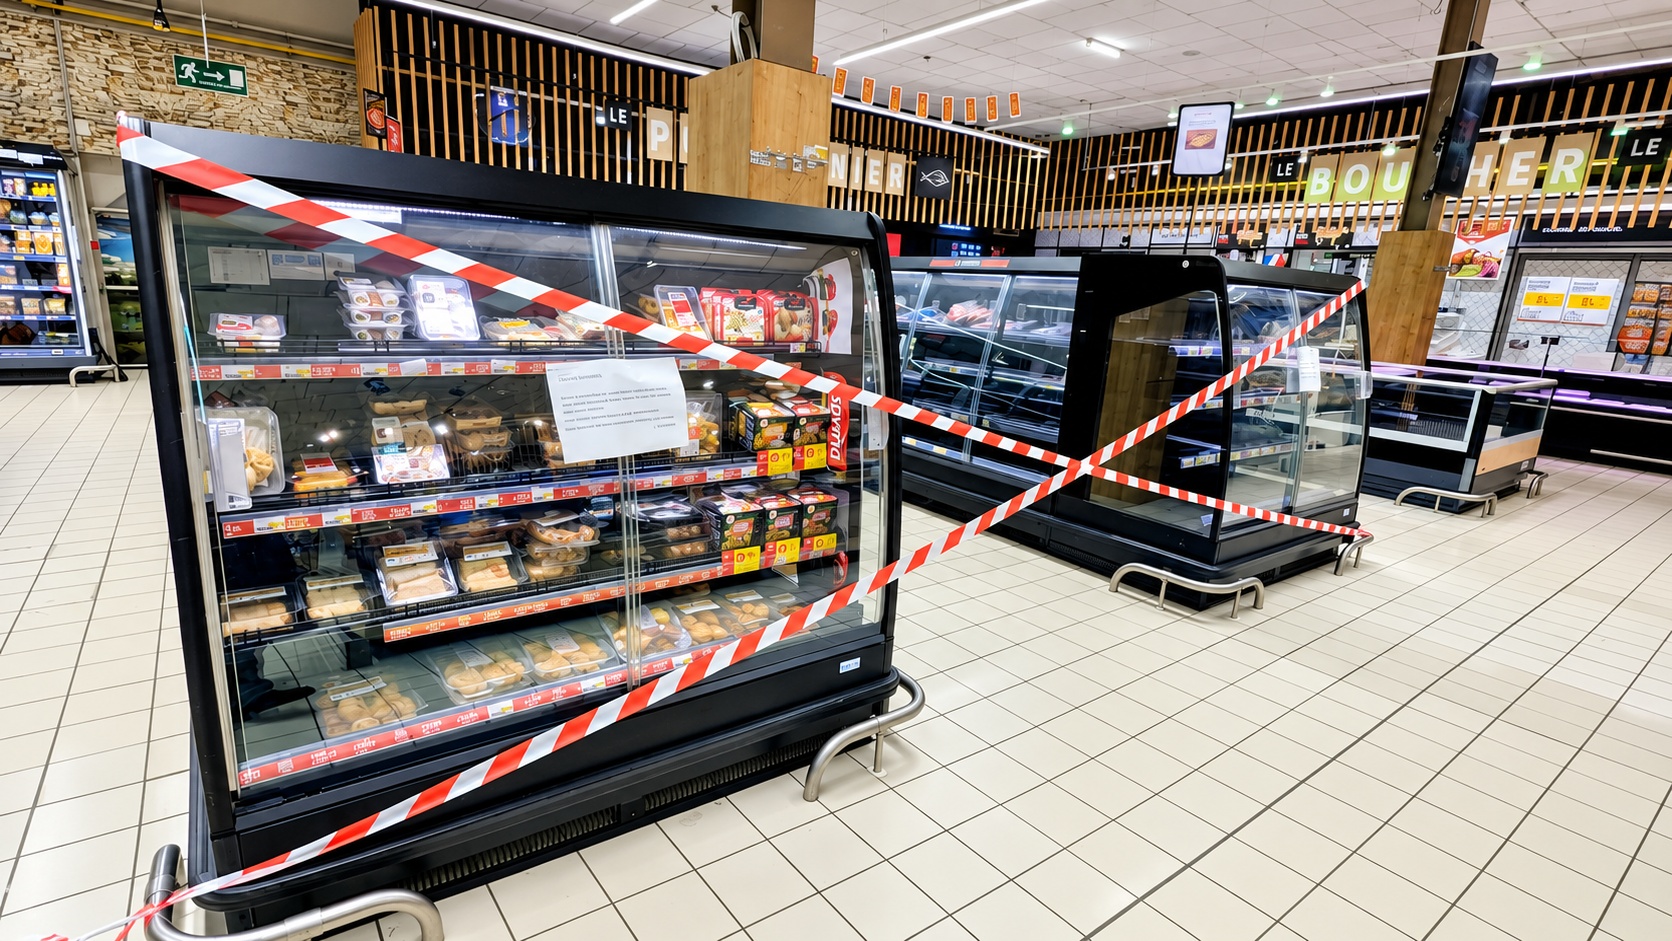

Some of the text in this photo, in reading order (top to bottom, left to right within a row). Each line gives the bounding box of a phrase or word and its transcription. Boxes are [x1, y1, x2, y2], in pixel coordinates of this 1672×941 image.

[609, 106, 628, 125] LE
[1630, 136, 1661, 157] LE
[1276, 147, 1585, 196] LE BOUHER
